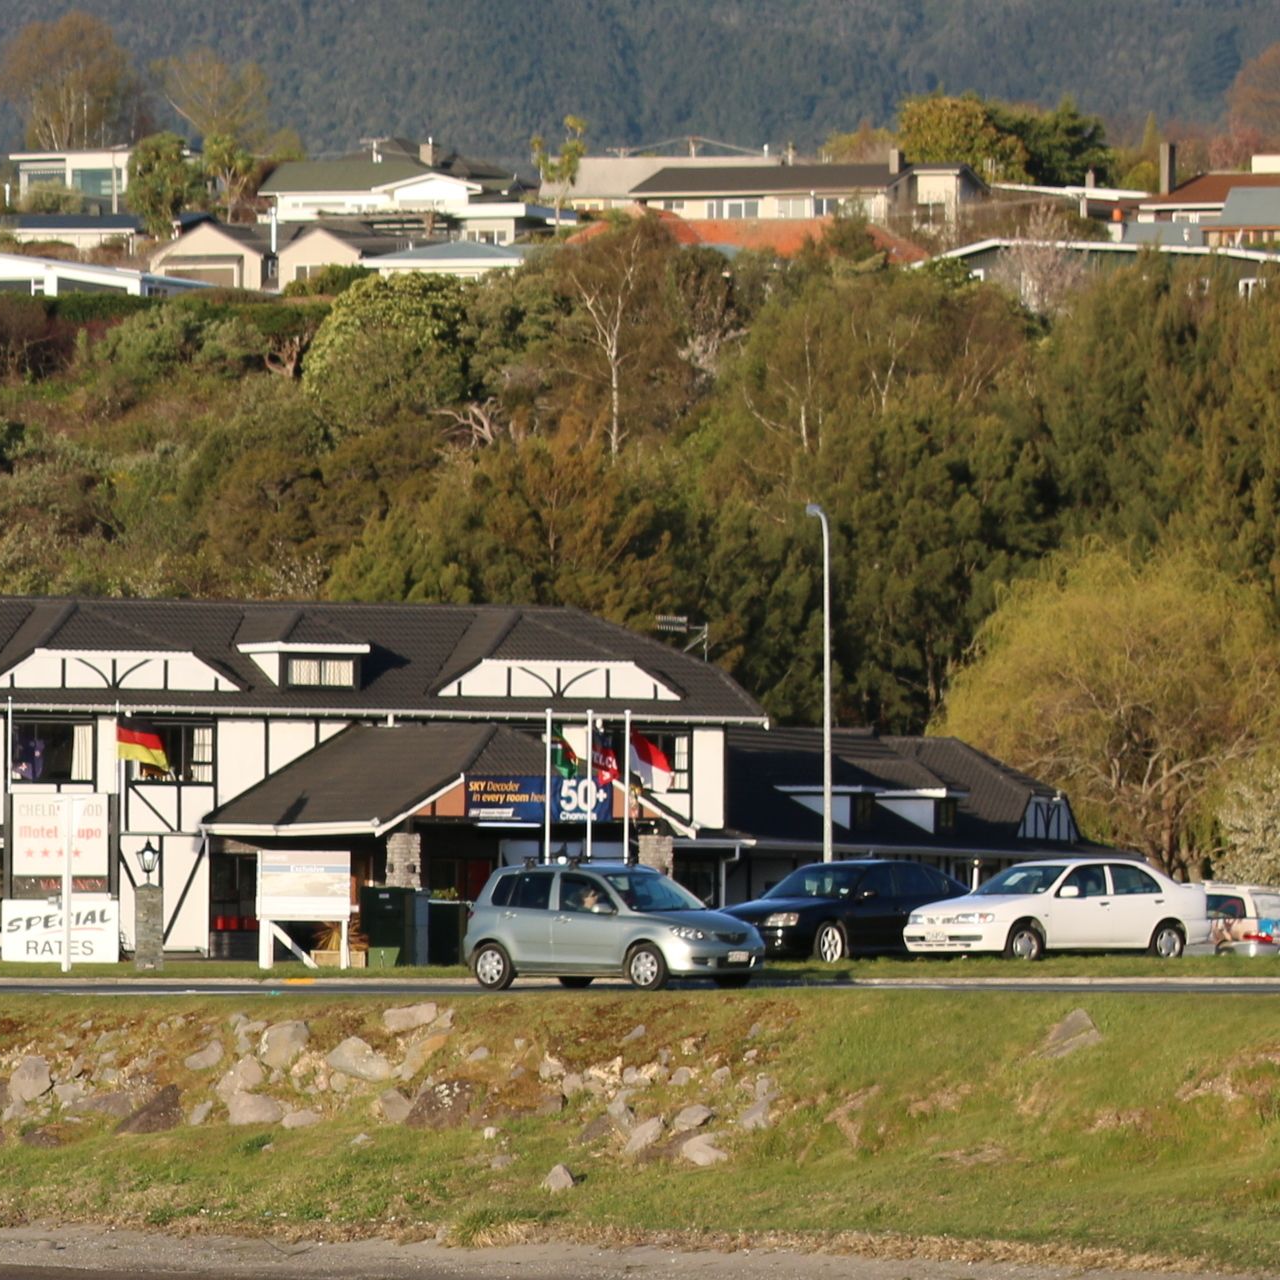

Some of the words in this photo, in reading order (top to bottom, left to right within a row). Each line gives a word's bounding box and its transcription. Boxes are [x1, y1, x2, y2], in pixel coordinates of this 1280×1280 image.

[468, 781, 486, 791] SKY
[487, 780, 520, 791] Decoder
[473, 792, 481, 802] in
[482, 794, 506, 804] every
[507, 794, 529, 802] room
[560, 779, 607, 812] 50+
[19, 825, 59, 839] Motel
